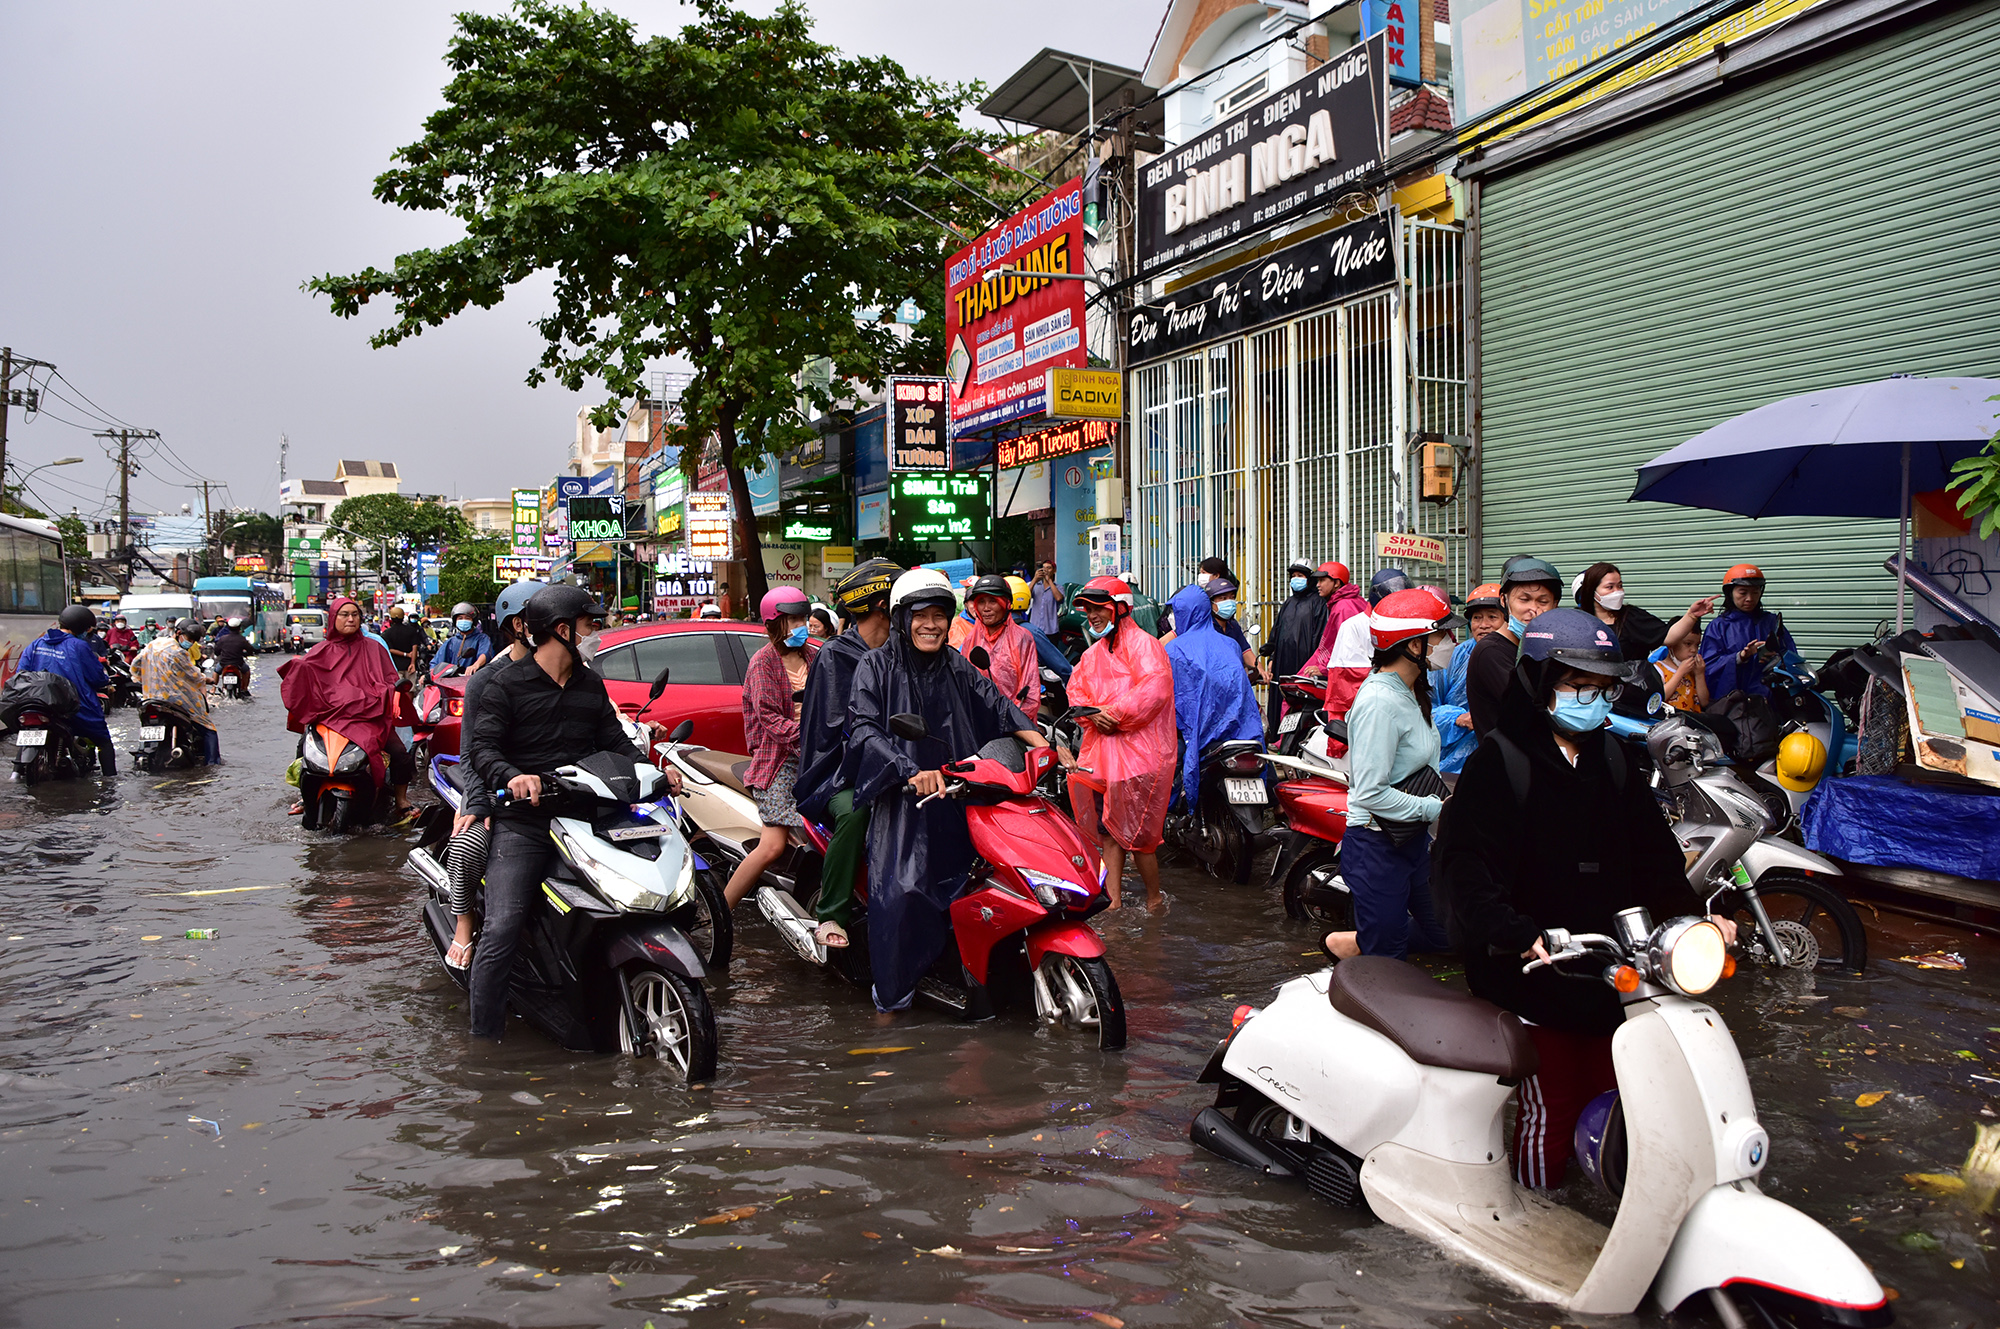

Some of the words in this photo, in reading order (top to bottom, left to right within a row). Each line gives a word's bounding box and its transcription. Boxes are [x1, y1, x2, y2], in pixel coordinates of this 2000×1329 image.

[1581, 20, 1610, 45] GÁC
[1613, 2, 1643, 29] SÀN
[1147, 158, 1173, 188] ĐÈN
[1176, 134, 1221, 172] TRANG
[1225, 113, 1249, 147] TRÍ
[1263, 89, 1301, 127] ĐIỆN
[1318, 53, 1368, 98] NƯỚC
[1165, 153, 1246, 236] BÌNH
[1251, 109, 1337, 196] NGA
[949, 258, 968, 288] KHO
[969, 246, 976, 276] SỈ
[981, 237, 992, 269] LẺ
[992, 224, 1013, 262] XỐP
[1015, 214, 1038, 249] DÁN
[1131, 314, 1158, 347] Đèn
[1163, 301, 1208, 335] Trang
[1213, 282, 1241, 318] Trí
[1262, 262, 1306, 304] Điện
[1331, 231, 1387, 277] Nước
[1007, 382, 1027, 398] CÔNG
[1027, 374, 1045, 392] THEO
[1098, 376, 1119, 386] NGA
[896, 384, 926, 401] KHO
[927, 381, 943, 401] SỈ
[1060, 389, 1117, 404] CADIVI
[905, 403, 935, 424] XỐP
[905, 426, 936, 444] DÁN
[1017, 436, 1039, 461] Dán
[1040, 427, 1080, 453] Tường
[897, 446, 945, 466] TƯỜNG
[902, 479, 948, 495] SIMILI
[516, 507, 538, 523] in
[515, 524, 538, 535] BẠT
[571, 519, 623, 539] KHOA
[517, 535, 536, 545] PP
[1389, 535, 1416, 547] Sky
[1419, 539, 1440, 551] Lite
[1383, 546, 1428, 559] PolyDura
[1430, 552, 1443, 563] Lite
[655, 577, 683, 596] GIÁ
[687, 574, 716, 595] TỐT
[657, 598, 678, 608] NỆM
[680, 597, 696, 606] GIÁ
[1230, 779, 1259, 790] 77-L1
[1230, 791, 1264, 802] 428.17
